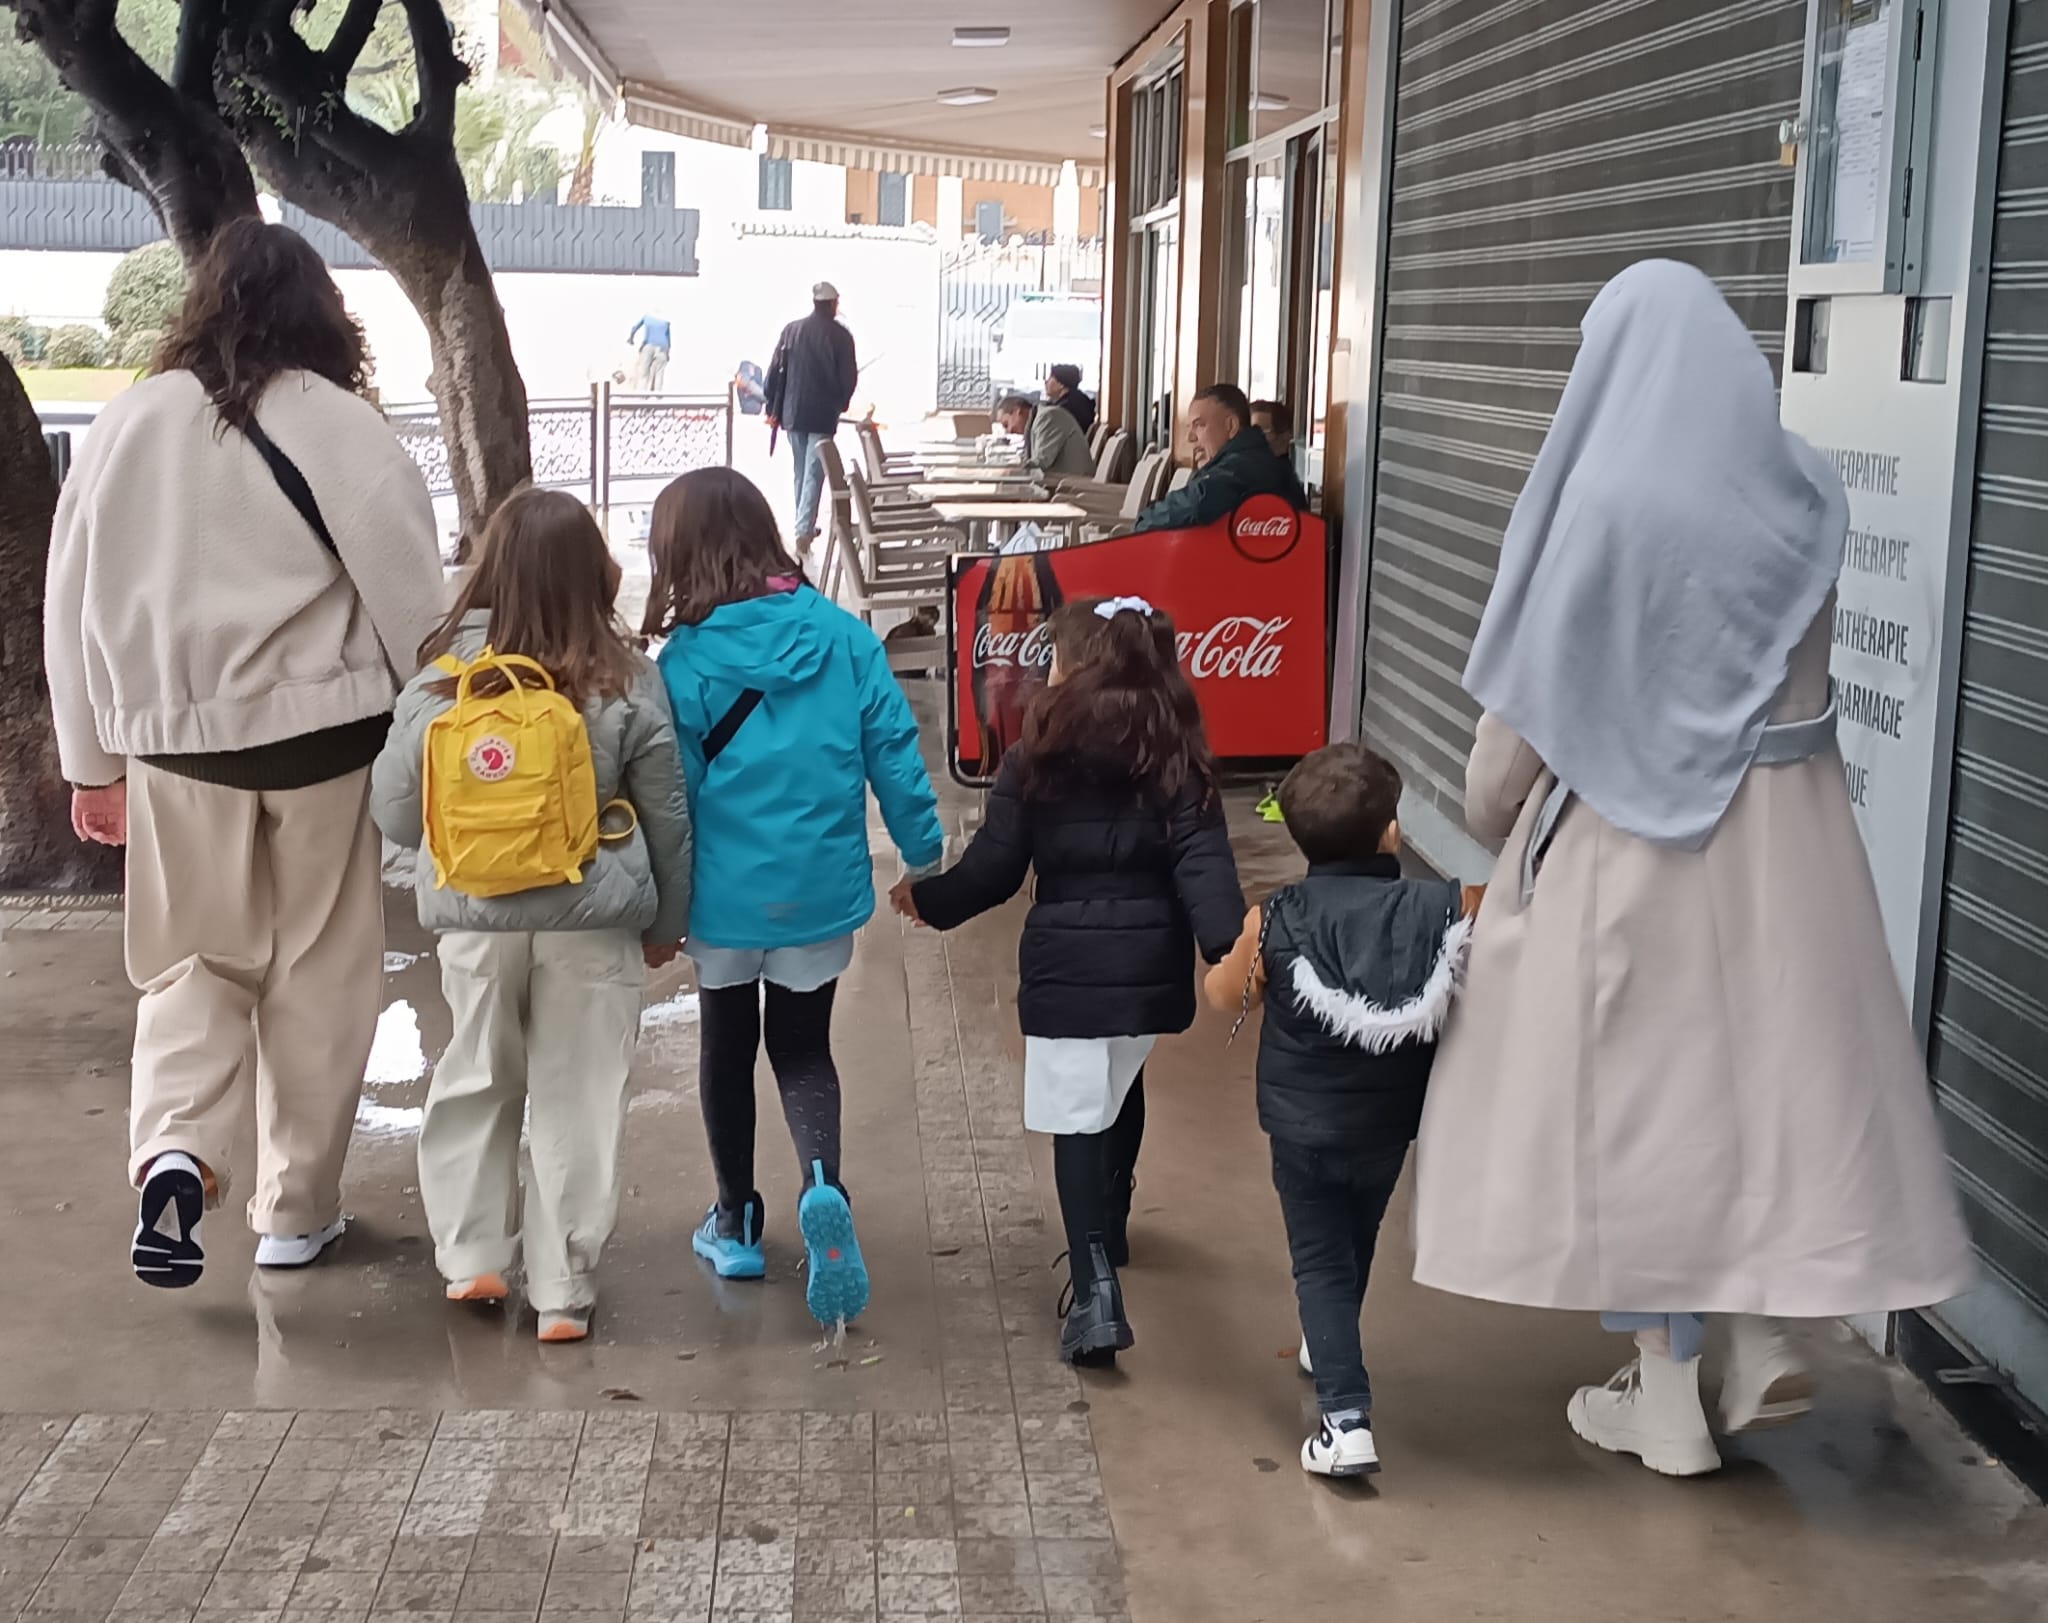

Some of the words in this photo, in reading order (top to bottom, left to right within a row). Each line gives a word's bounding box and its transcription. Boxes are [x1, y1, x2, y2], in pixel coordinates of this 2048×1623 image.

[1847, 525, 1910, 581] THÉRAPIE
[972, 622, 1053, 669] Coca-Co
[1836, 678, 1905, 740] HARMACIE
[1844, 761, 1869, 808] QUE
